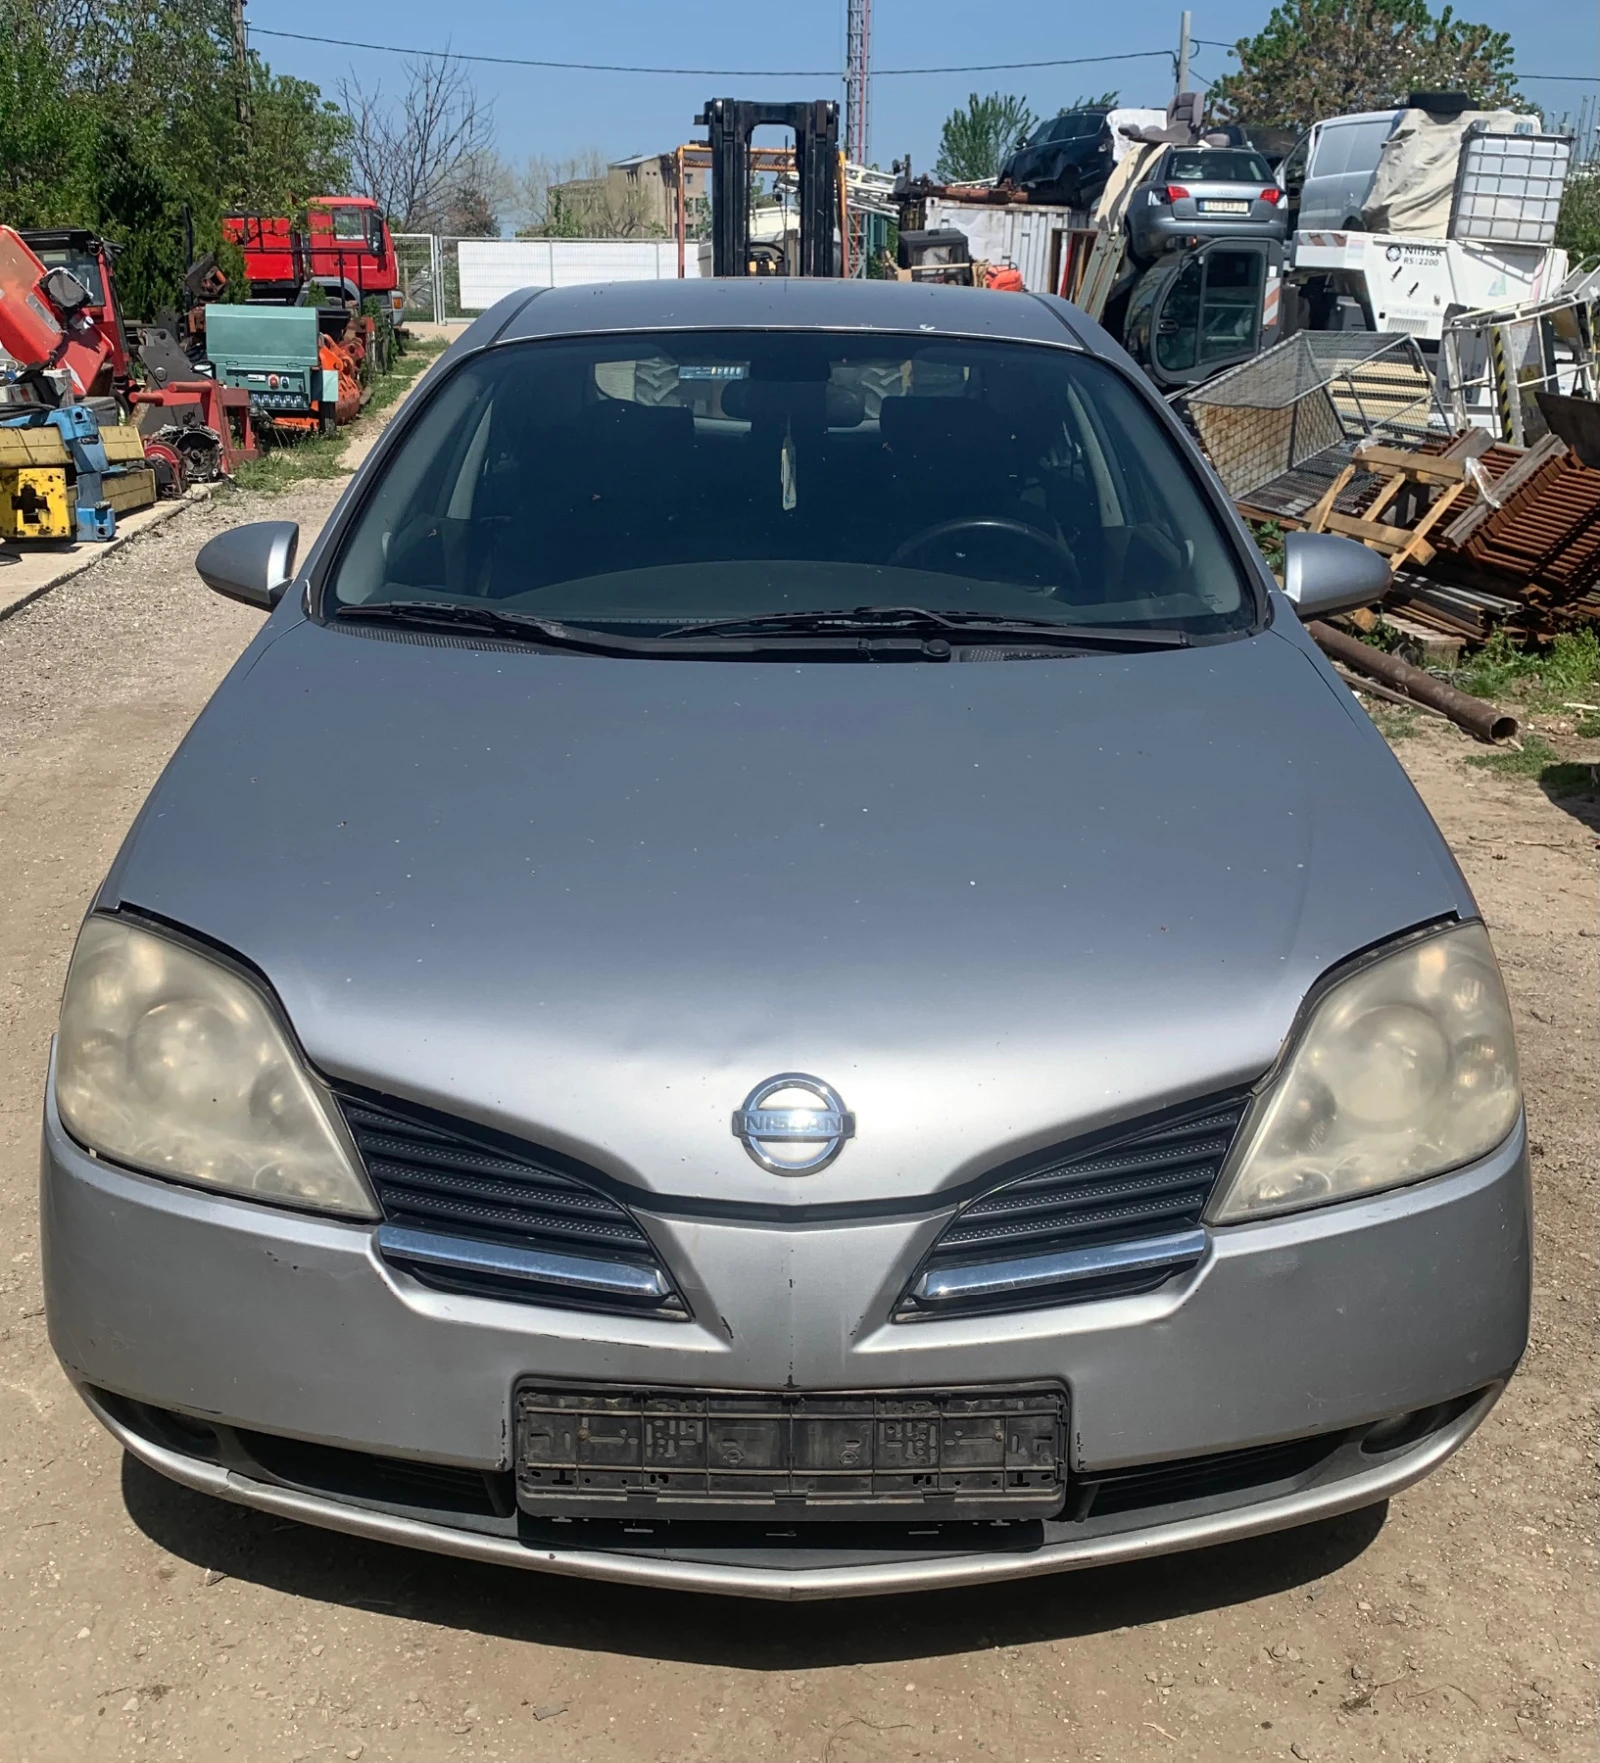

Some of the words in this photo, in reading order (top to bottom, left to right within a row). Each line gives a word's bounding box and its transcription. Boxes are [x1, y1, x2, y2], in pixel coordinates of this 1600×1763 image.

[1405, 246, 1442, 257] Nilfisk
[1403, 257, 1414, 265] RS
[1418, 258, 1439, 266] 2200
[745, 1115, 843, 1133] NISSAN
